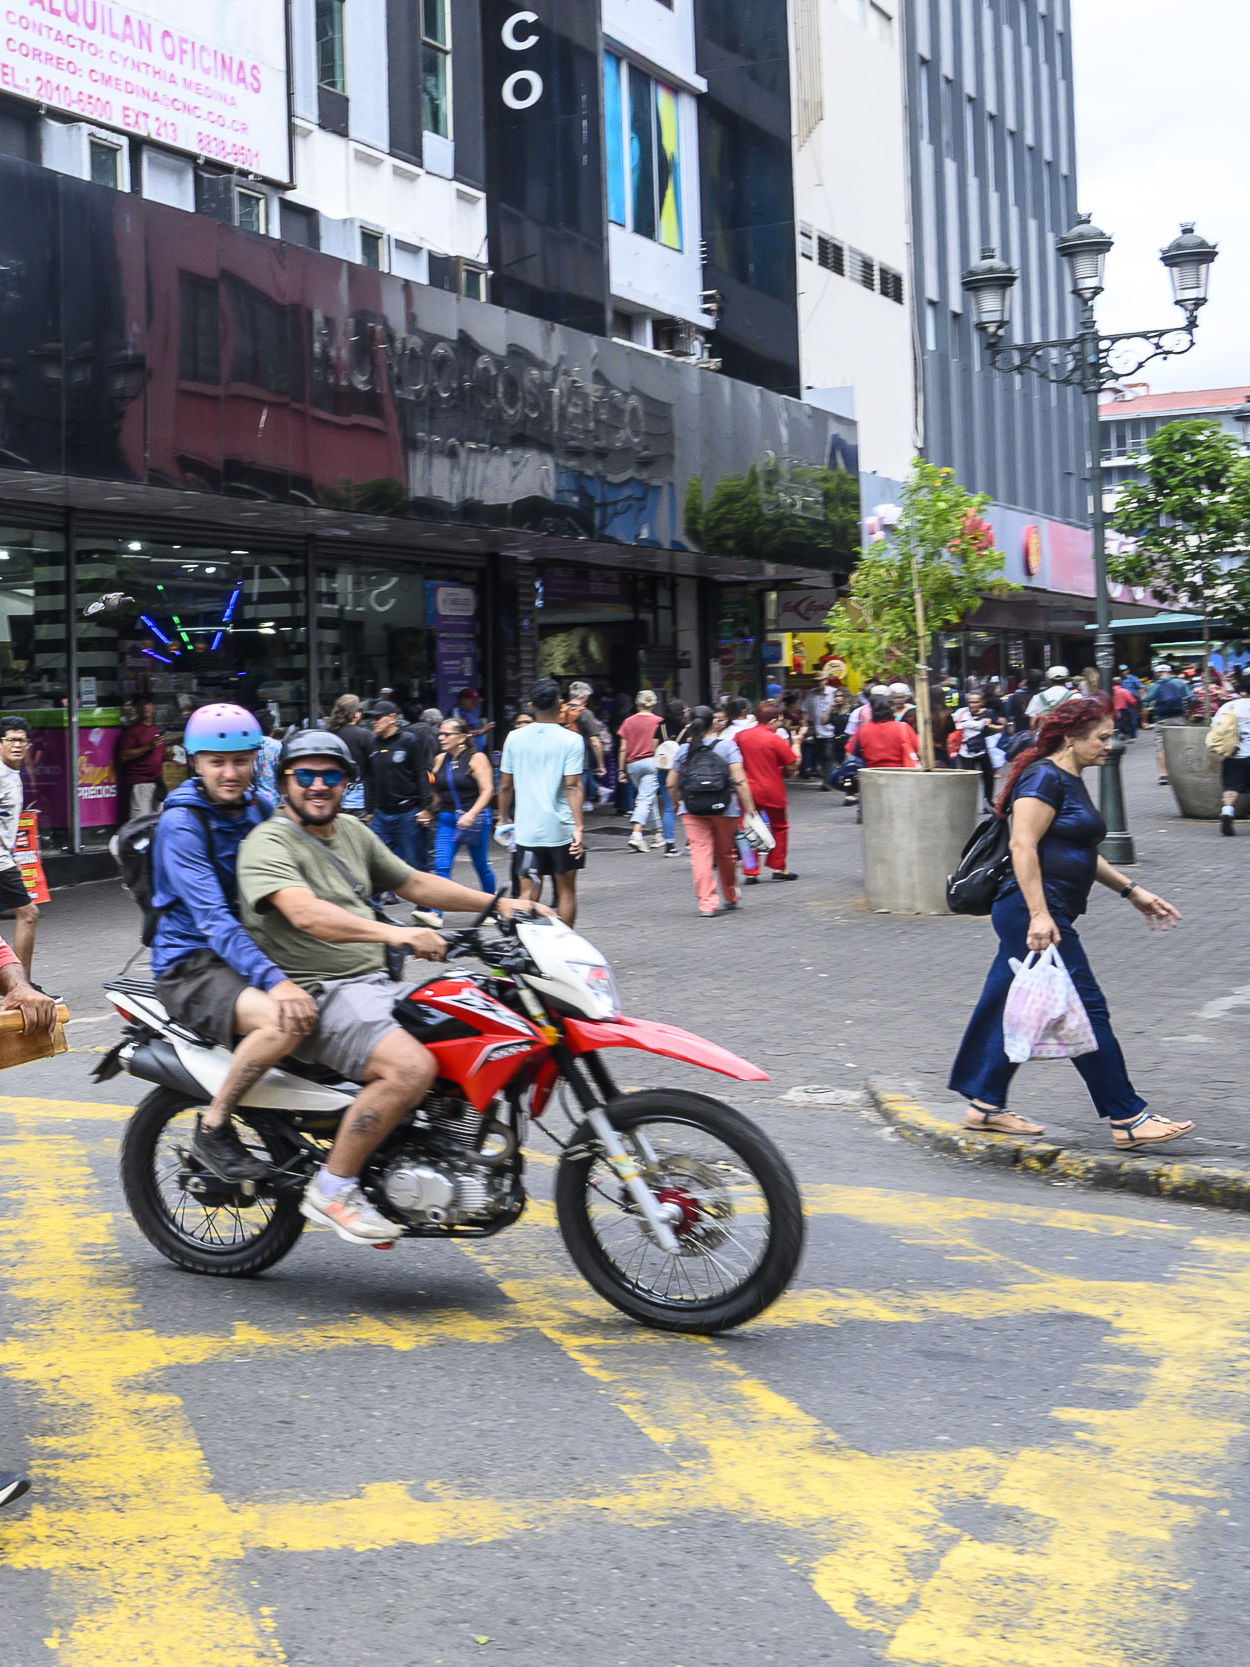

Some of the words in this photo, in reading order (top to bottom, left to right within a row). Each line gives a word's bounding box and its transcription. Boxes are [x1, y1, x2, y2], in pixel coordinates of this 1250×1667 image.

[6, 37, 83, 78] CORREO:
[6, 10, 103, 59] CONTACTO:
[109, 50, 178, 87] CYNTHIA
[182, 77, 238, 109] MEDINA
[30, 0, 152, 53] QUILAN
[161, 29, 261, 94] OFICINAS
[35, 76, 113, 122] 2010-6500
